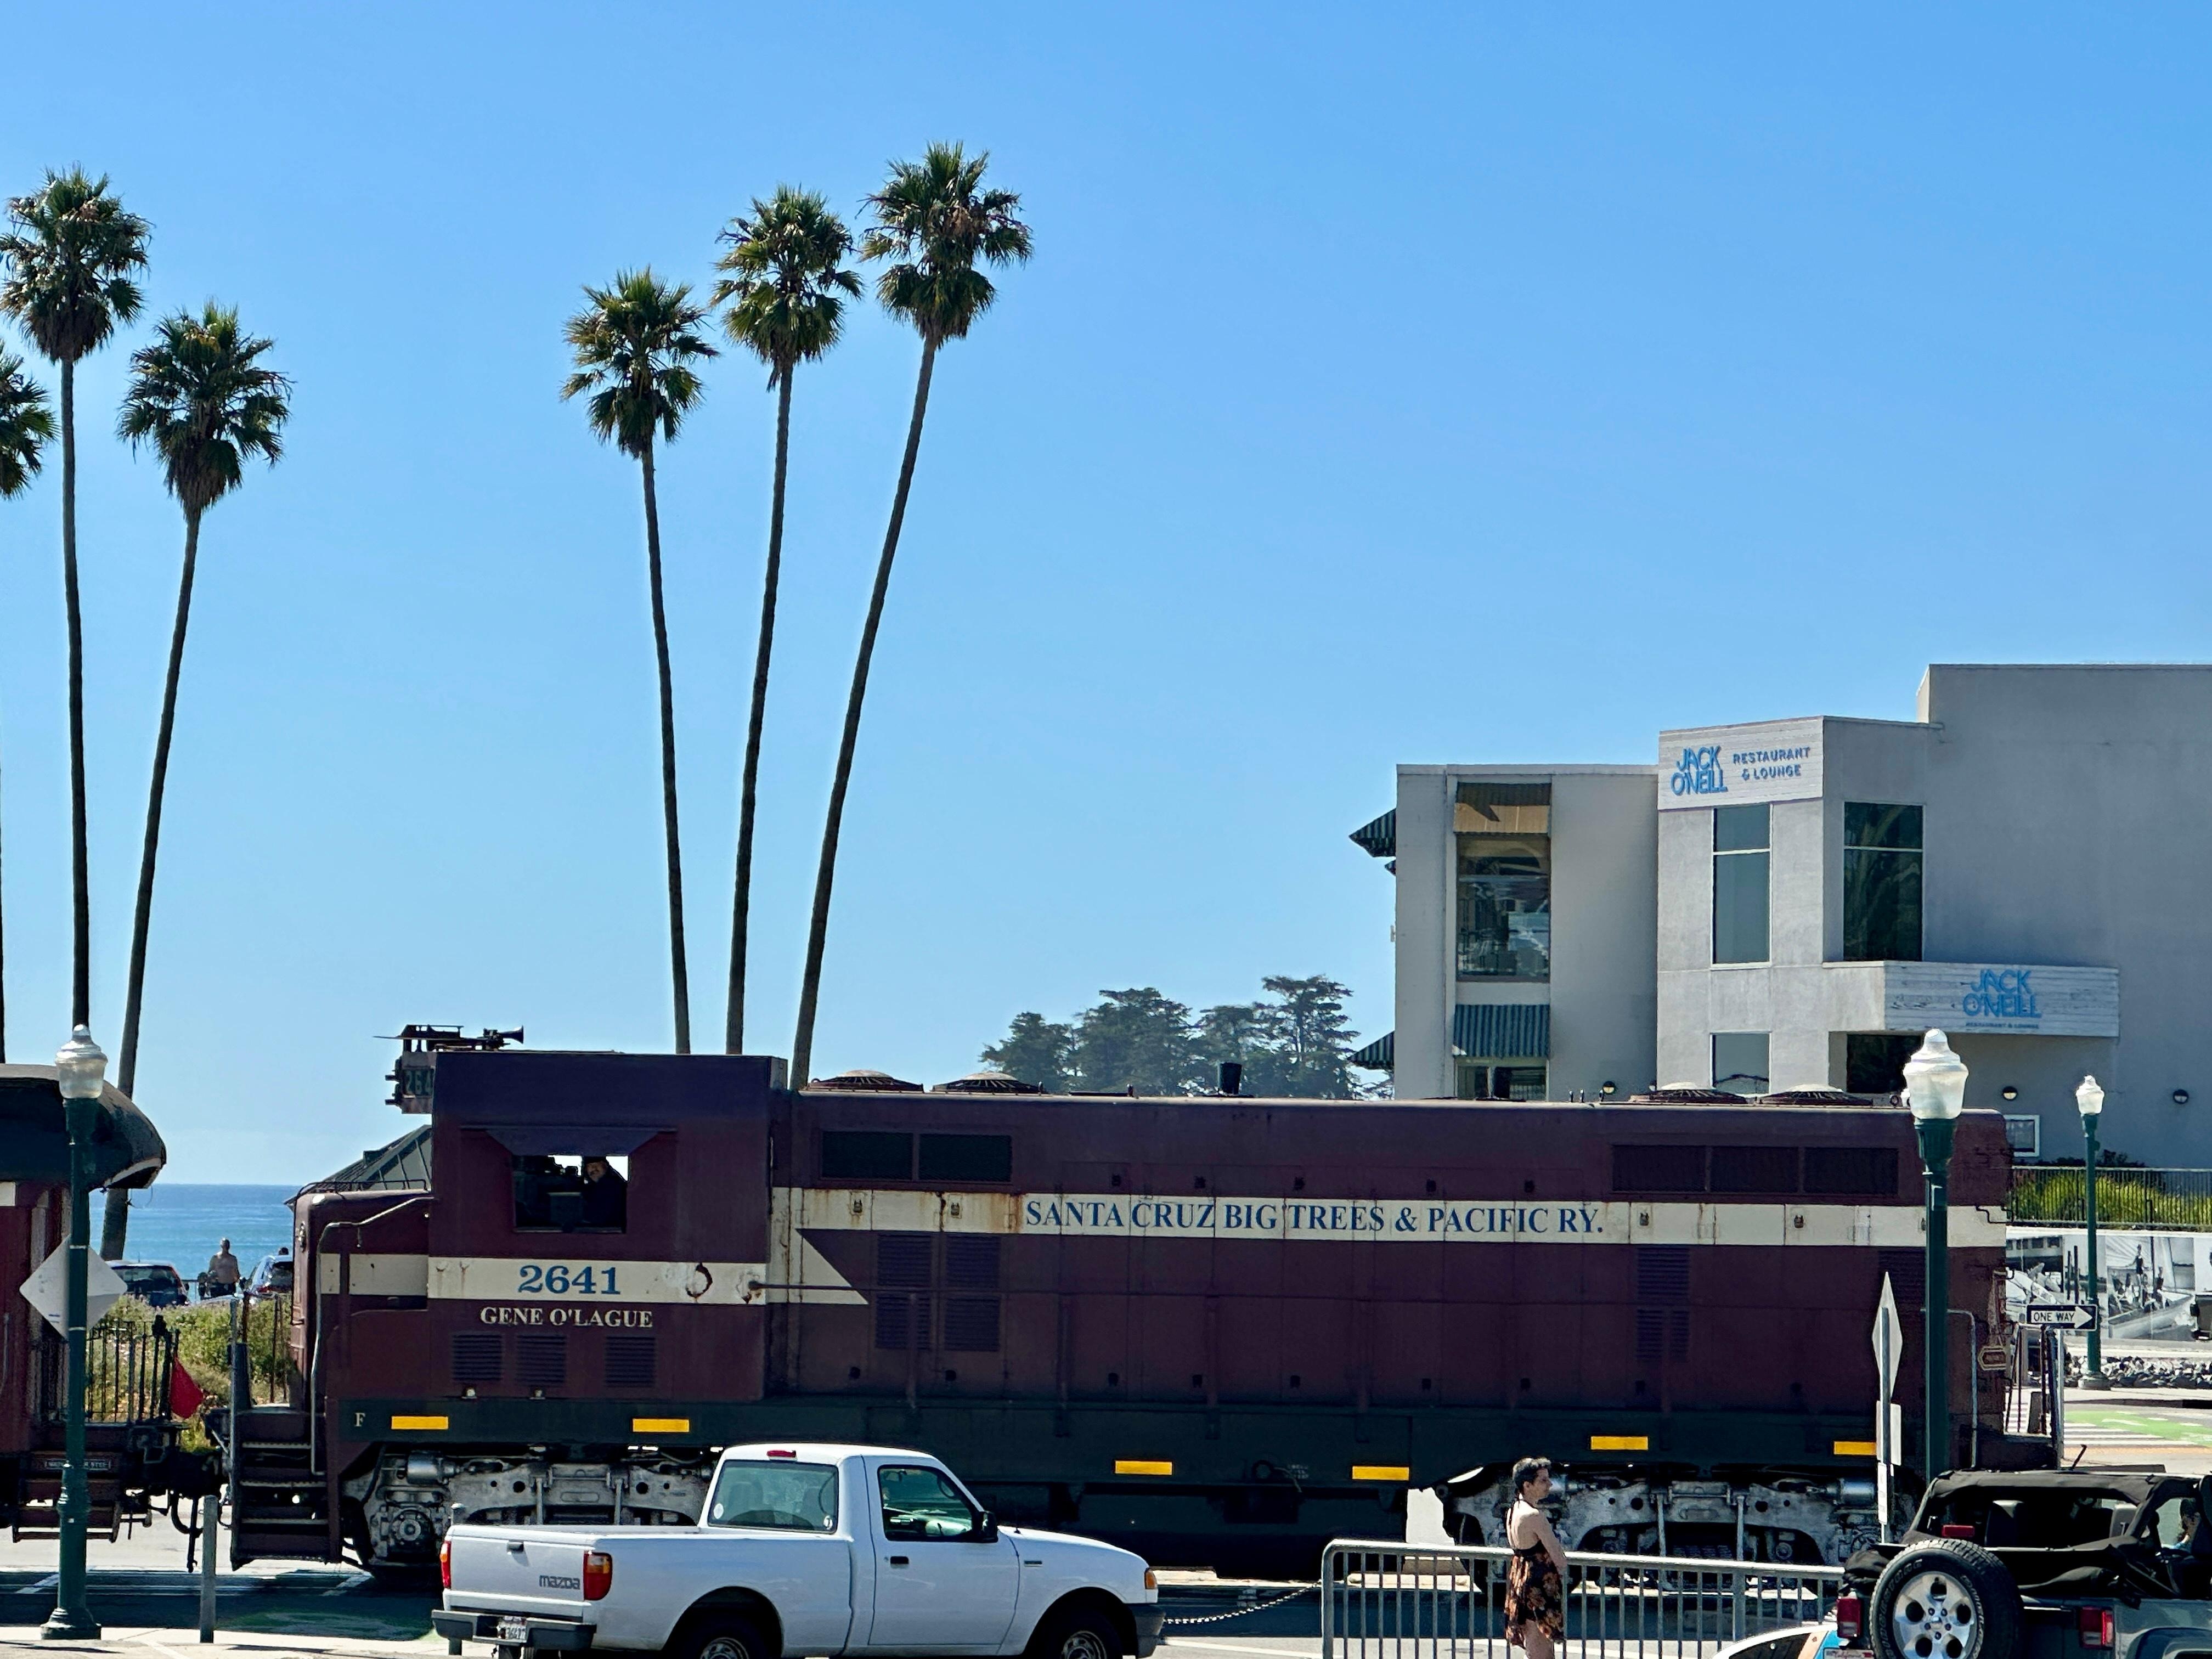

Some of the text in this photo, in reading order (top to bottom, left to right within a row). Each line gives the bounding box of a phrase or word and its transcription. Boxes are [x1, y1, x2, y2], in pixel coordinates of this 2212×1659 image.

[1676, 744, 1722, 771] JACK
[1733, 746, 1810, 765] RESTAURANT
[1741, 764, 1802, 781] & LOUNGE
[1970, 969, 2032, 994] JACK
[1026, 1200, 1604, 1234] SANTA CRUZ BIG TREES & PACIFIC RY.
[518, 1265, 621, 1295] 2641
[480, 1306, 653, 1328] GENE O'LAGUE
[2033, 1311, 2074, 1322] ONE WAY
[354, 1412, 366, 1427] F
[539, 1575, 580, 1590] mazda
